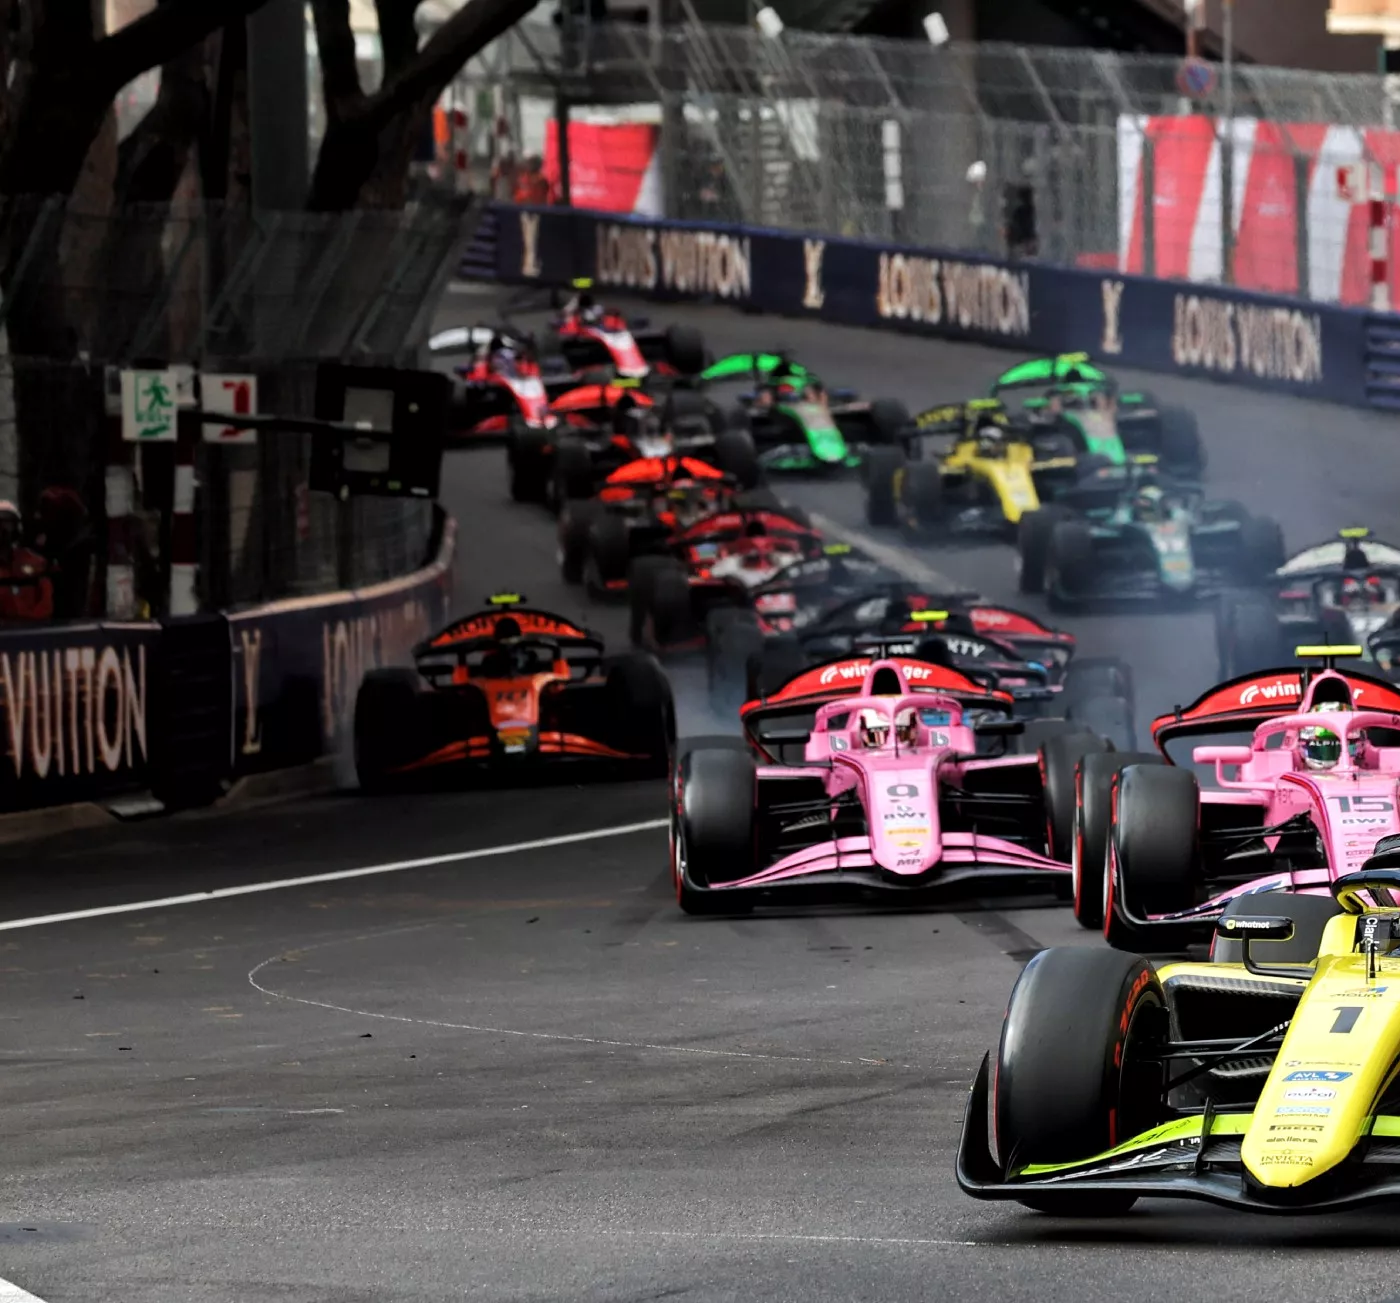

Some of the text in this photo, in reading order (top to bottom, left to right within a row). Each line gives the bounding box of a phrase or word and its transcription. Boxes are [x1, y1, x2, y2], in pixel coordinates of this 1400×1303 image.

[877, 252, 1030, 335] LOUIS VUITTON
[1172, 294, 1322, 383] LOUIS VUITTON
[1, 643, 149, 779] VUITTON
[886, 784, 919, 803] 9
[1327, 795, 1394, 813] 15
[1235, 920, 1271, 929] whatnot
[1328, 1006, 1365, 1034] 1
[1266, 1136, 1318, 1144] dallara
[1261, 1154, 1313, 1163] INVICTA
